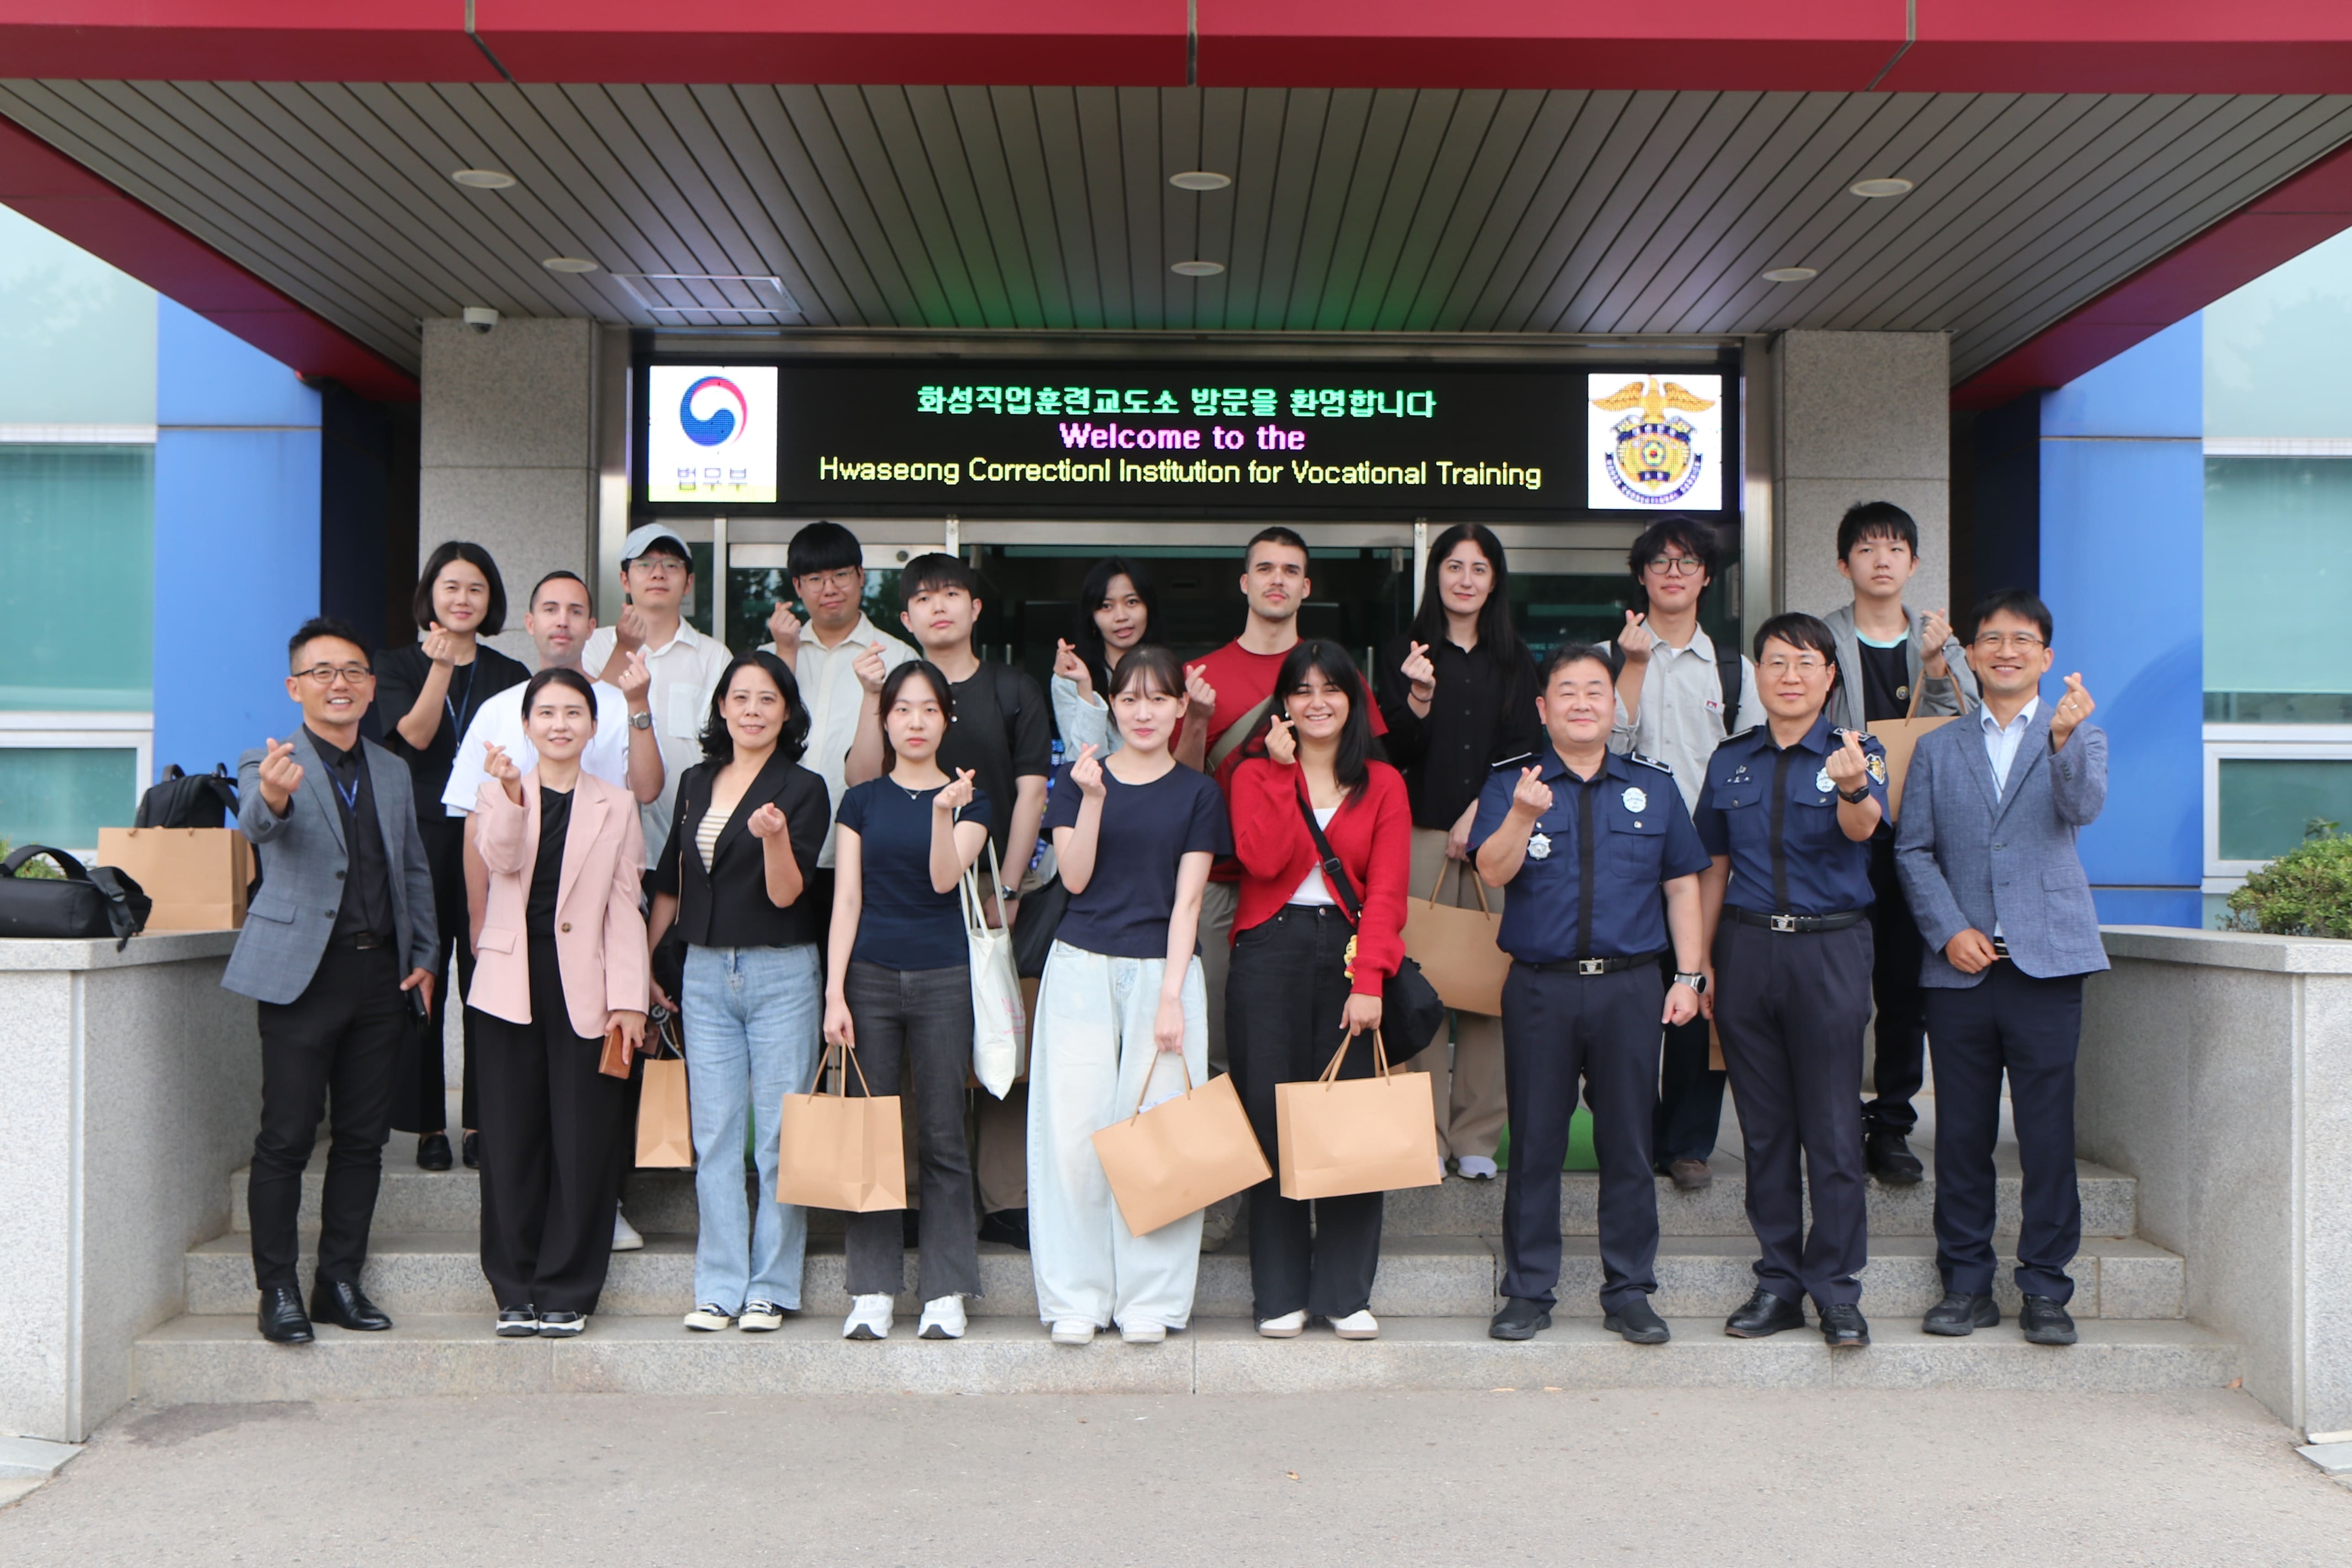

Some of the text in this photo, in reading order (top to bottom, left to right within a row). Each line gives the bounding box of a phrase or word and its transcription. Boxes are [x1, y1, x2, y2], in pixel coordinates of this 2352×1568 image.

[917, 386, 1436, 418] 화성직업훈련교도소 방문을 환영합니다
[1058, 422, 1306, 450] Welcome to the
[677, 467, 748, 491] 법무부
[820, 456, 1541, 490] Hwaseong Correctionl Institution for Vocational Training
